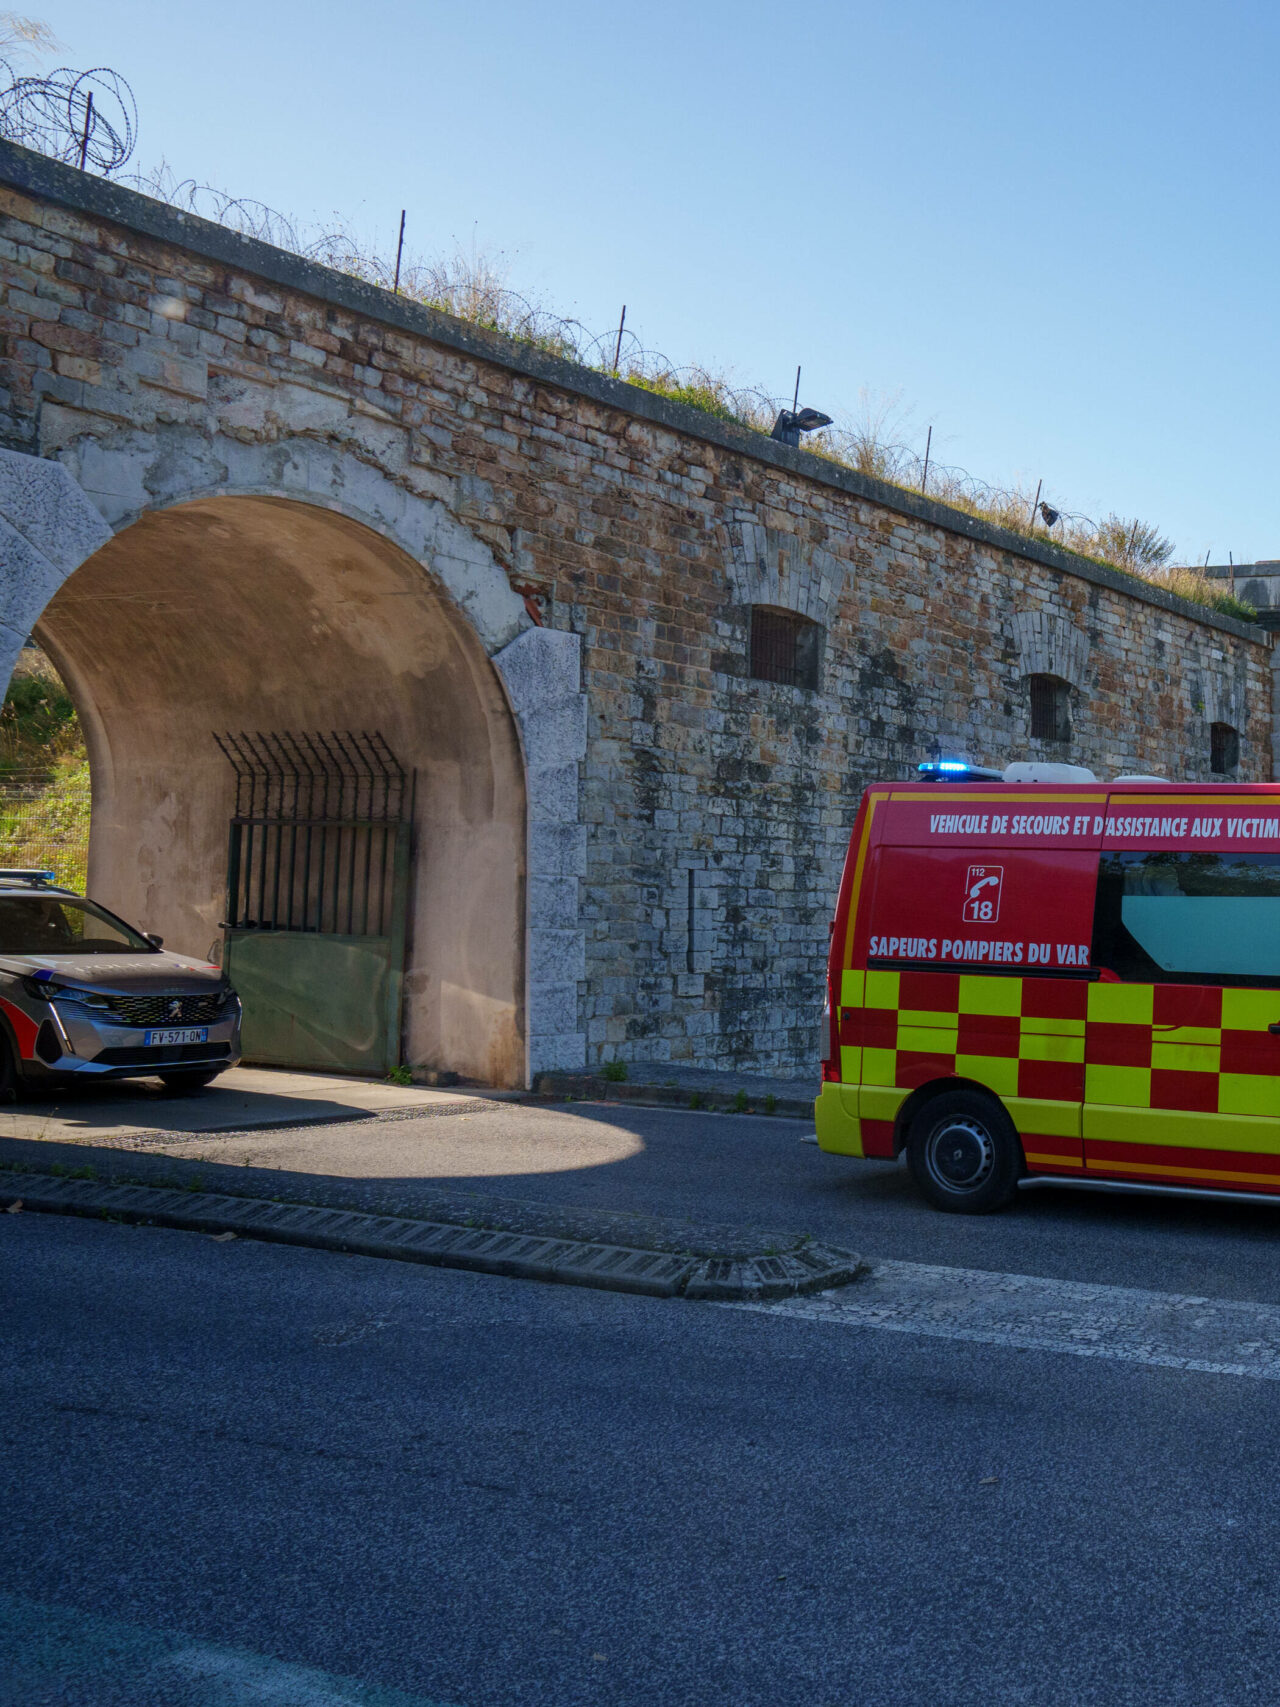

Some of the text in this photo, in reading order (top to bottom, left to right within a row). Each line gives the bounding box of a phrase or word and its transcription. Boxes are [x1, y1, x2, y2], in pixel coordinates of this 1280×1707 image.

[930, 814, 989, 834] VEHICULE
[991, 815, 1009, 834] DE
[1011, 815, 1070, 835] SECOURS
[1073, 816, 1090, 835] ET
[1093, 816, 1188, 837] D'ASSISTANCE
[1190, 818, 1223, 838] AUX
[971, 868, 985, 876] 112
[970, 901, 993, 920] 18
[869, 936, 1089, 965] SAPEURS POMPIERS DU VAR
